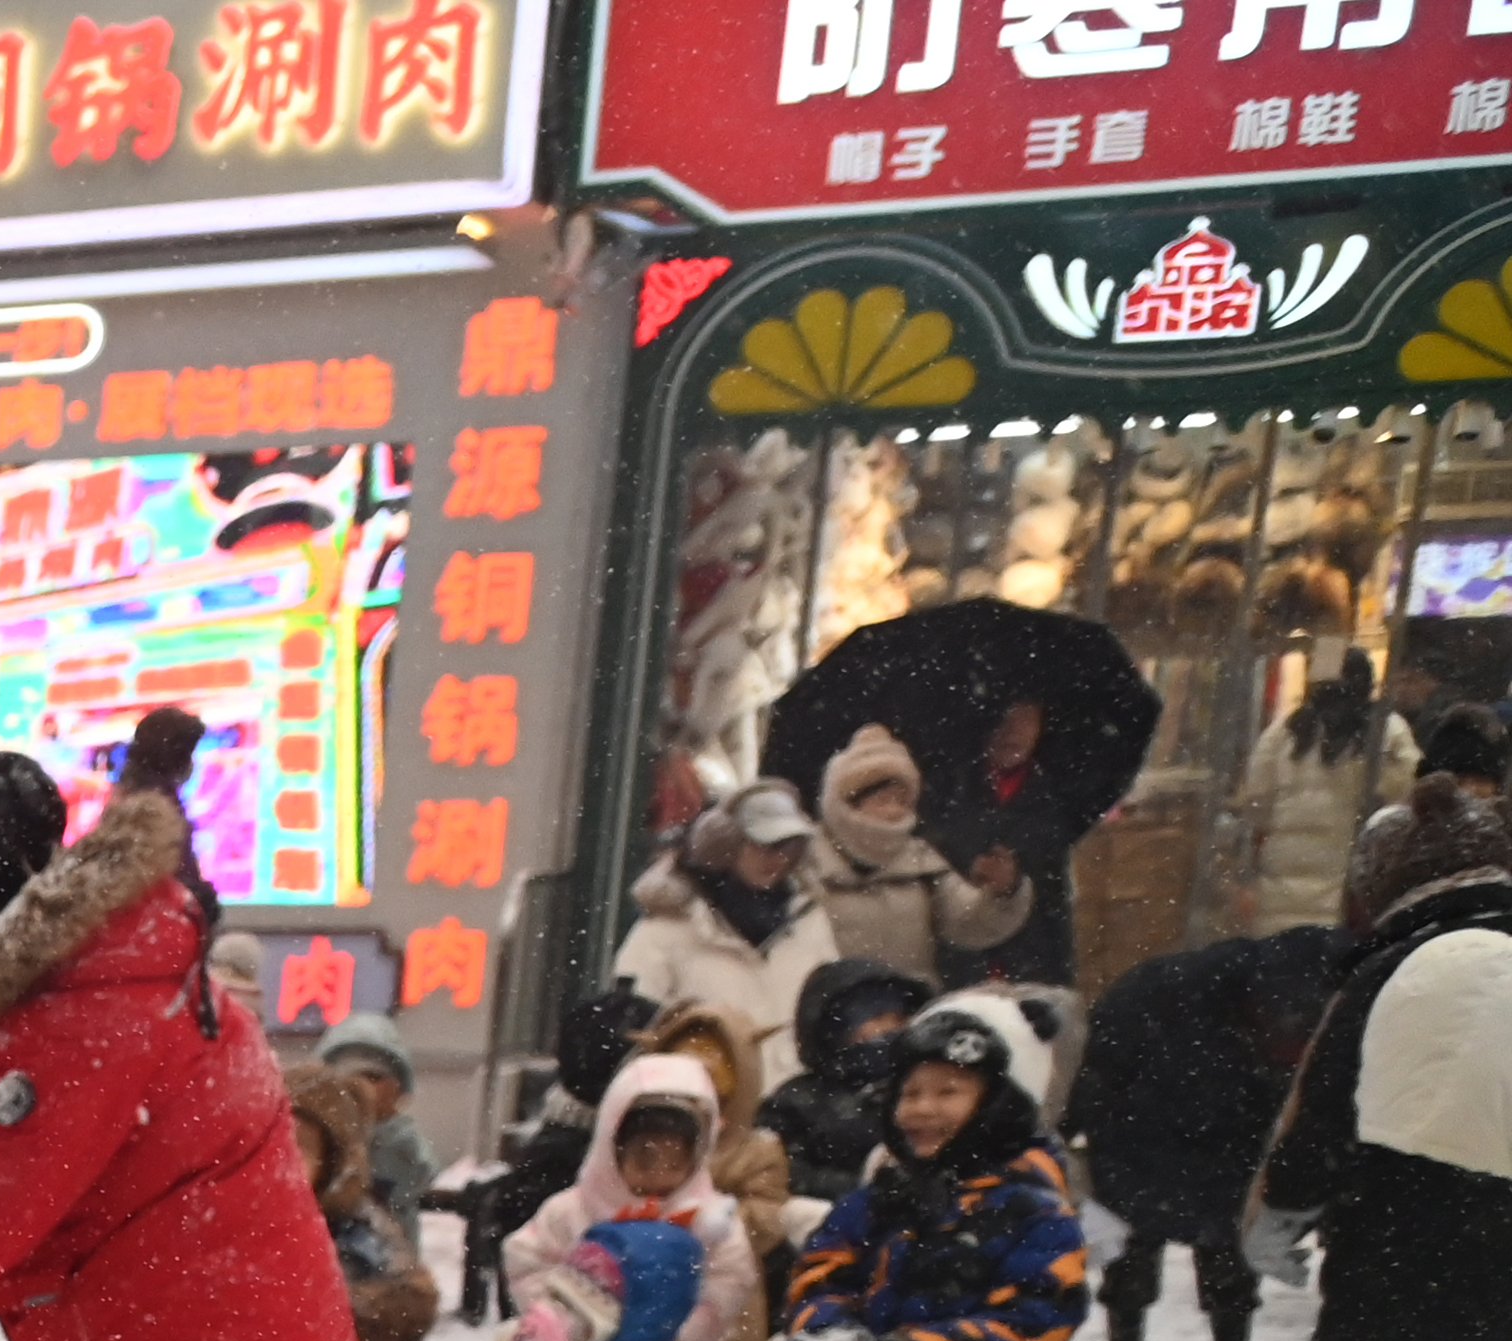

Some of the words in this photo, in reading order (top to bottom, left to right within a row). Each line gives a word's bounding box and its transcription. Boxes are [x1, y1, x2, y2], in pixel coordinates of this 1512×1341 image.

[826, 125, 948, 185] 帽子
[1024, 109, 1148, 170] 手套
[1228, 91, 1360, 153] 棉鞋
[402, 297, 557, 1007] 鼎源铜锅涮肉
[278, 938, 354, 1025] 肉
